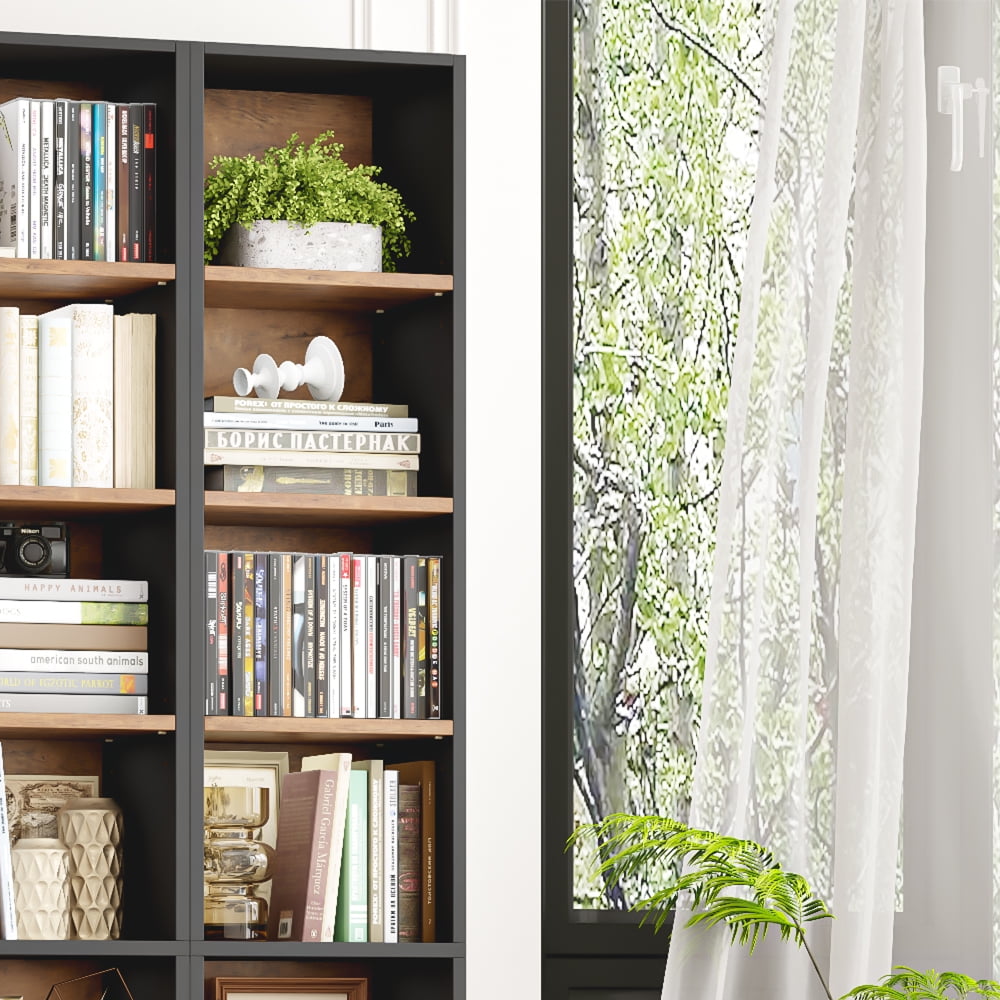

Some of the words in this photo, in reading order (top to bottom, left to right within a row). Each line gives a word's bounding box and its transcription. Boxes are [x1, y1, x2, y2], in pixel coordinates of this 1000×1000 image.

[271, 400, 281, 409] ОТ
[284, 401, 327, 411] ПРОСТОГО
[337, 404, 389, 414] СЛОЖНОМУ
[217, 431, 283, 449] БОРИС
[291, 432, 410, 452] ПАСТЕРНАК
[24, 583, 61, 593] HAPPY
[70, 584, 122, 594] ANIMALS
[30, 655, 75, 665] american
[78, 655, 104, 666] south
[107, 656, 144, 667] animals
[81, 679, 114, 690] PARROT
[321, 778, 335, 815] Gabriel
[317, 817, 331, 849] García
[312, 851, 328, 896] Márquez
